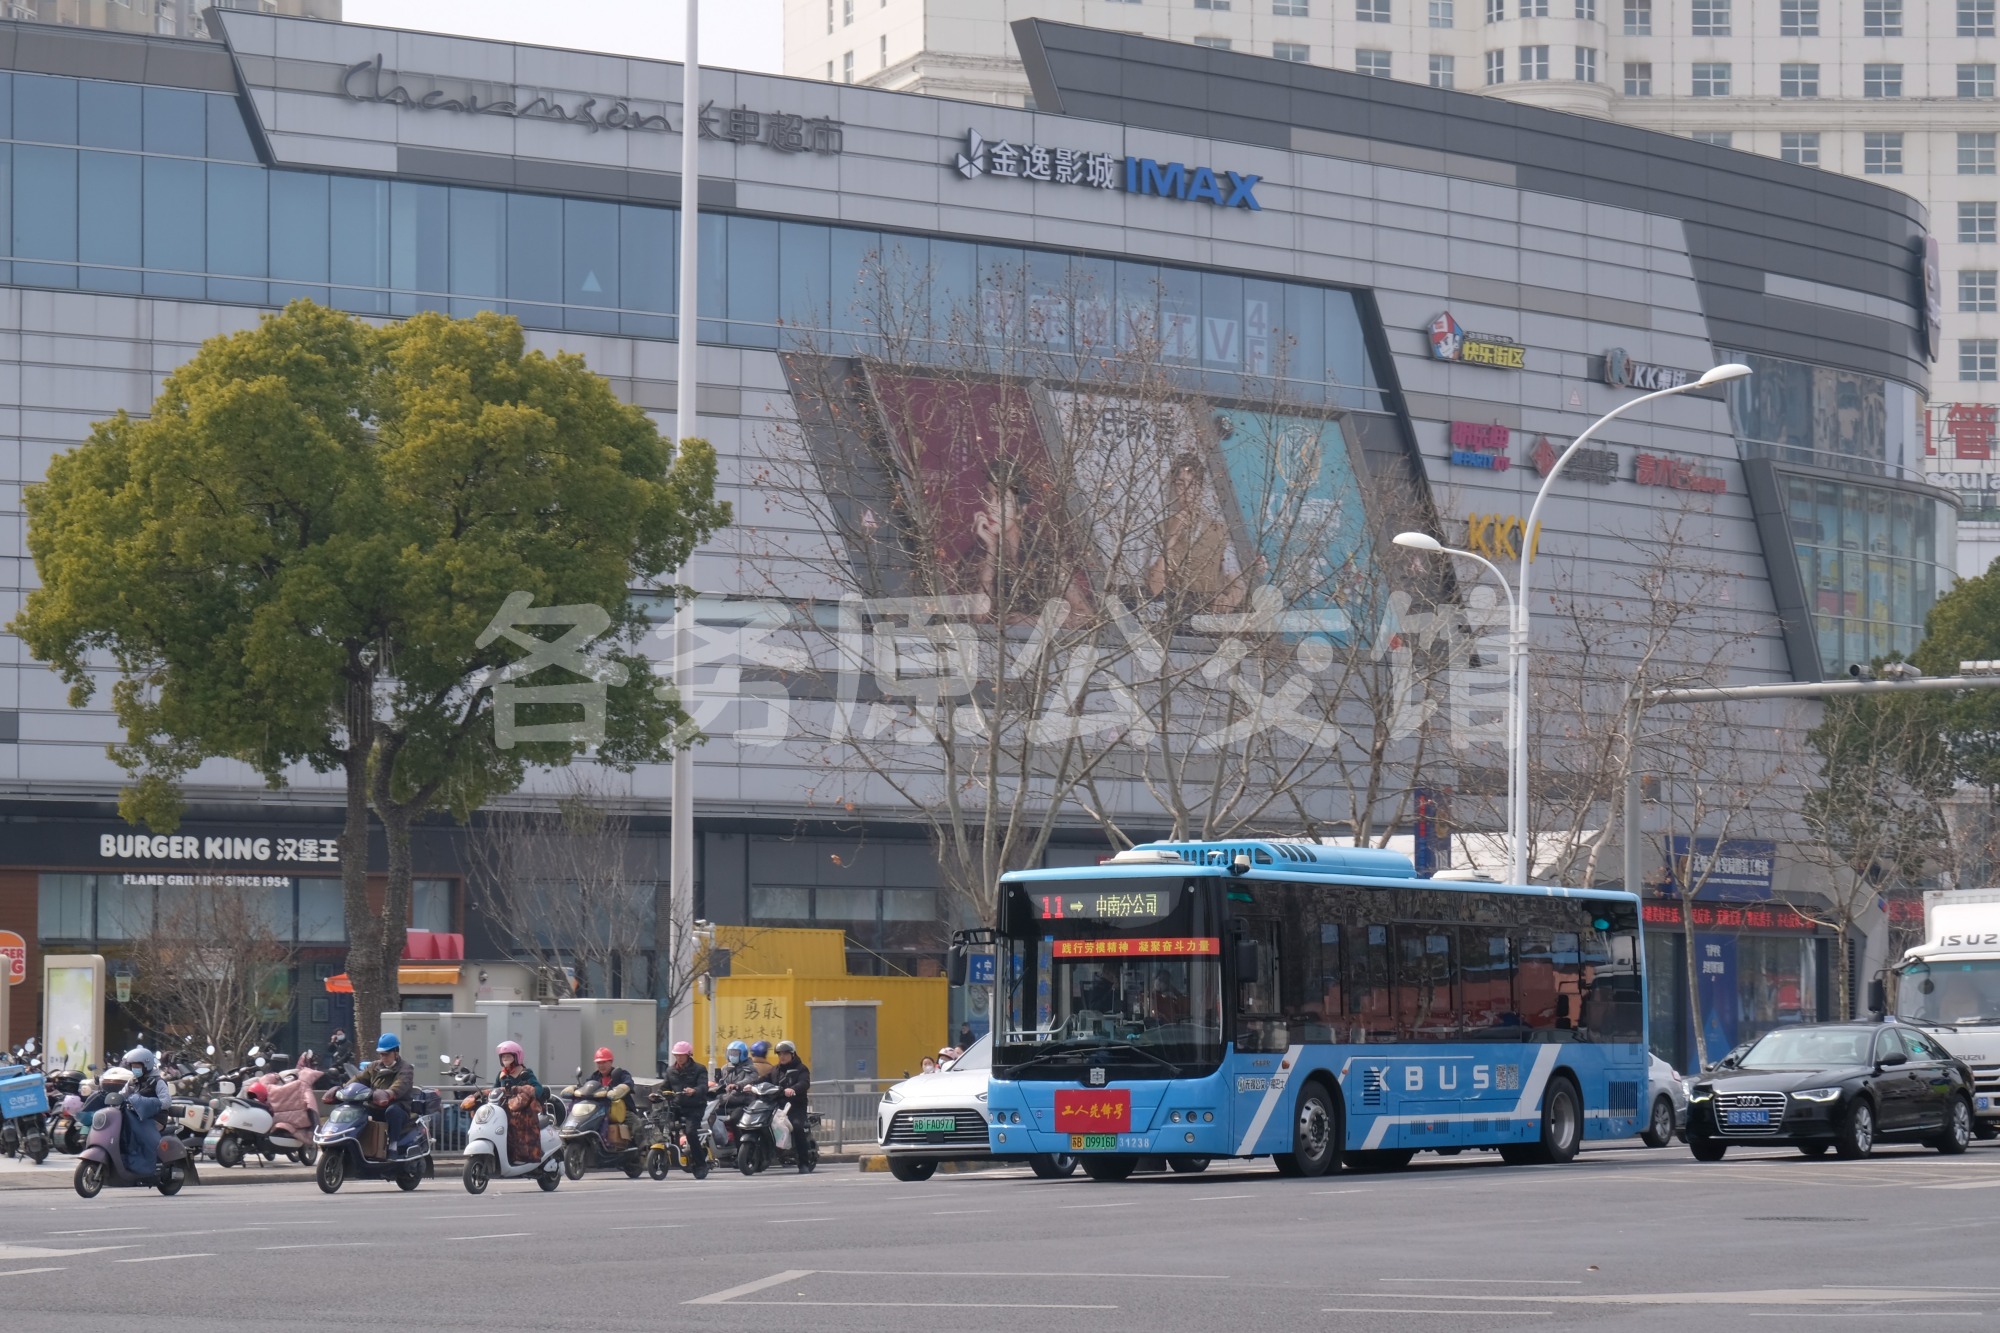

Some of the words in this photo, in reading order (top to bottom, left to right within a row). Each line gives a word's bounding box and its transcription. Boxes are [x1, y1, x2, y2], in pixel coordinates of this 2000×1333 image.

[990, 139, 1115, 190] 金逸影城
[1125, 156, 1263, 211] IMAX
[1462, 341, 1525, 368] 快乐街区
[1468, 511, 1542, 565] KKV
[100, 834, 200, 859] BURGER
[204, 836, 271, 860] KING
[276, 838, 340, 862] 汉堡王
[123, 875, 164, 886] FLAME
[225, 876, 260, 887] SINCE
[262, 877, 289, 887] 1954
[1042, 896, 1063, 918] 11
[1096, 893, 1157, 917] 中南分公司
[1061, 942, 1129, 954] 践行劳模精神
[1138, 940, 1210, 953] 凝聚奋斗力量
[744, 998, 783, 1020] 勇敢
[1061, 1103, 1123, 1119] 工人先锋号
[1119, 1138, 1150, 1148] 31238
